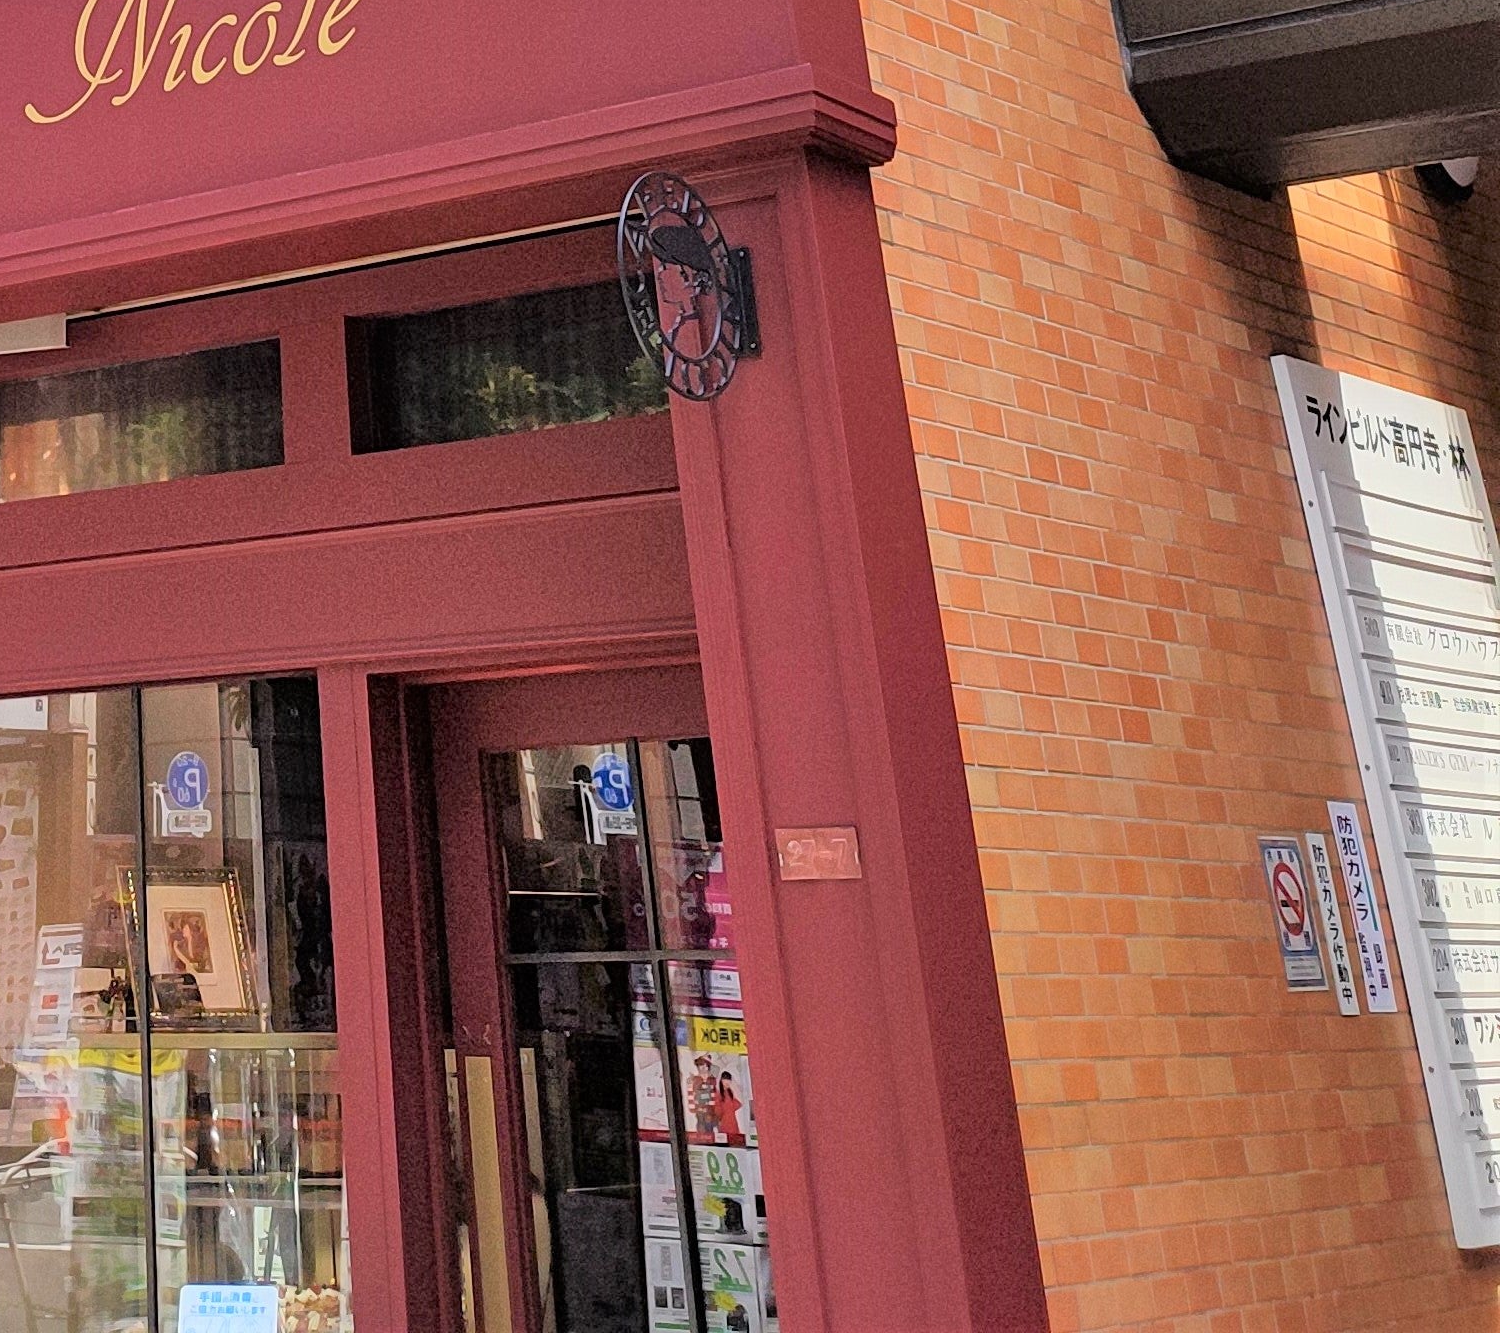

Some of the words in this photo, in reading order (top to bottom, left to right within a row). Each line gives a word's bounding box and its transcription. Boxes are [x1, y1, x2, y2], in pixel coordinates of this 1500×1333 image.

[1336, 815, 1369, 922] 防犯カメラ
